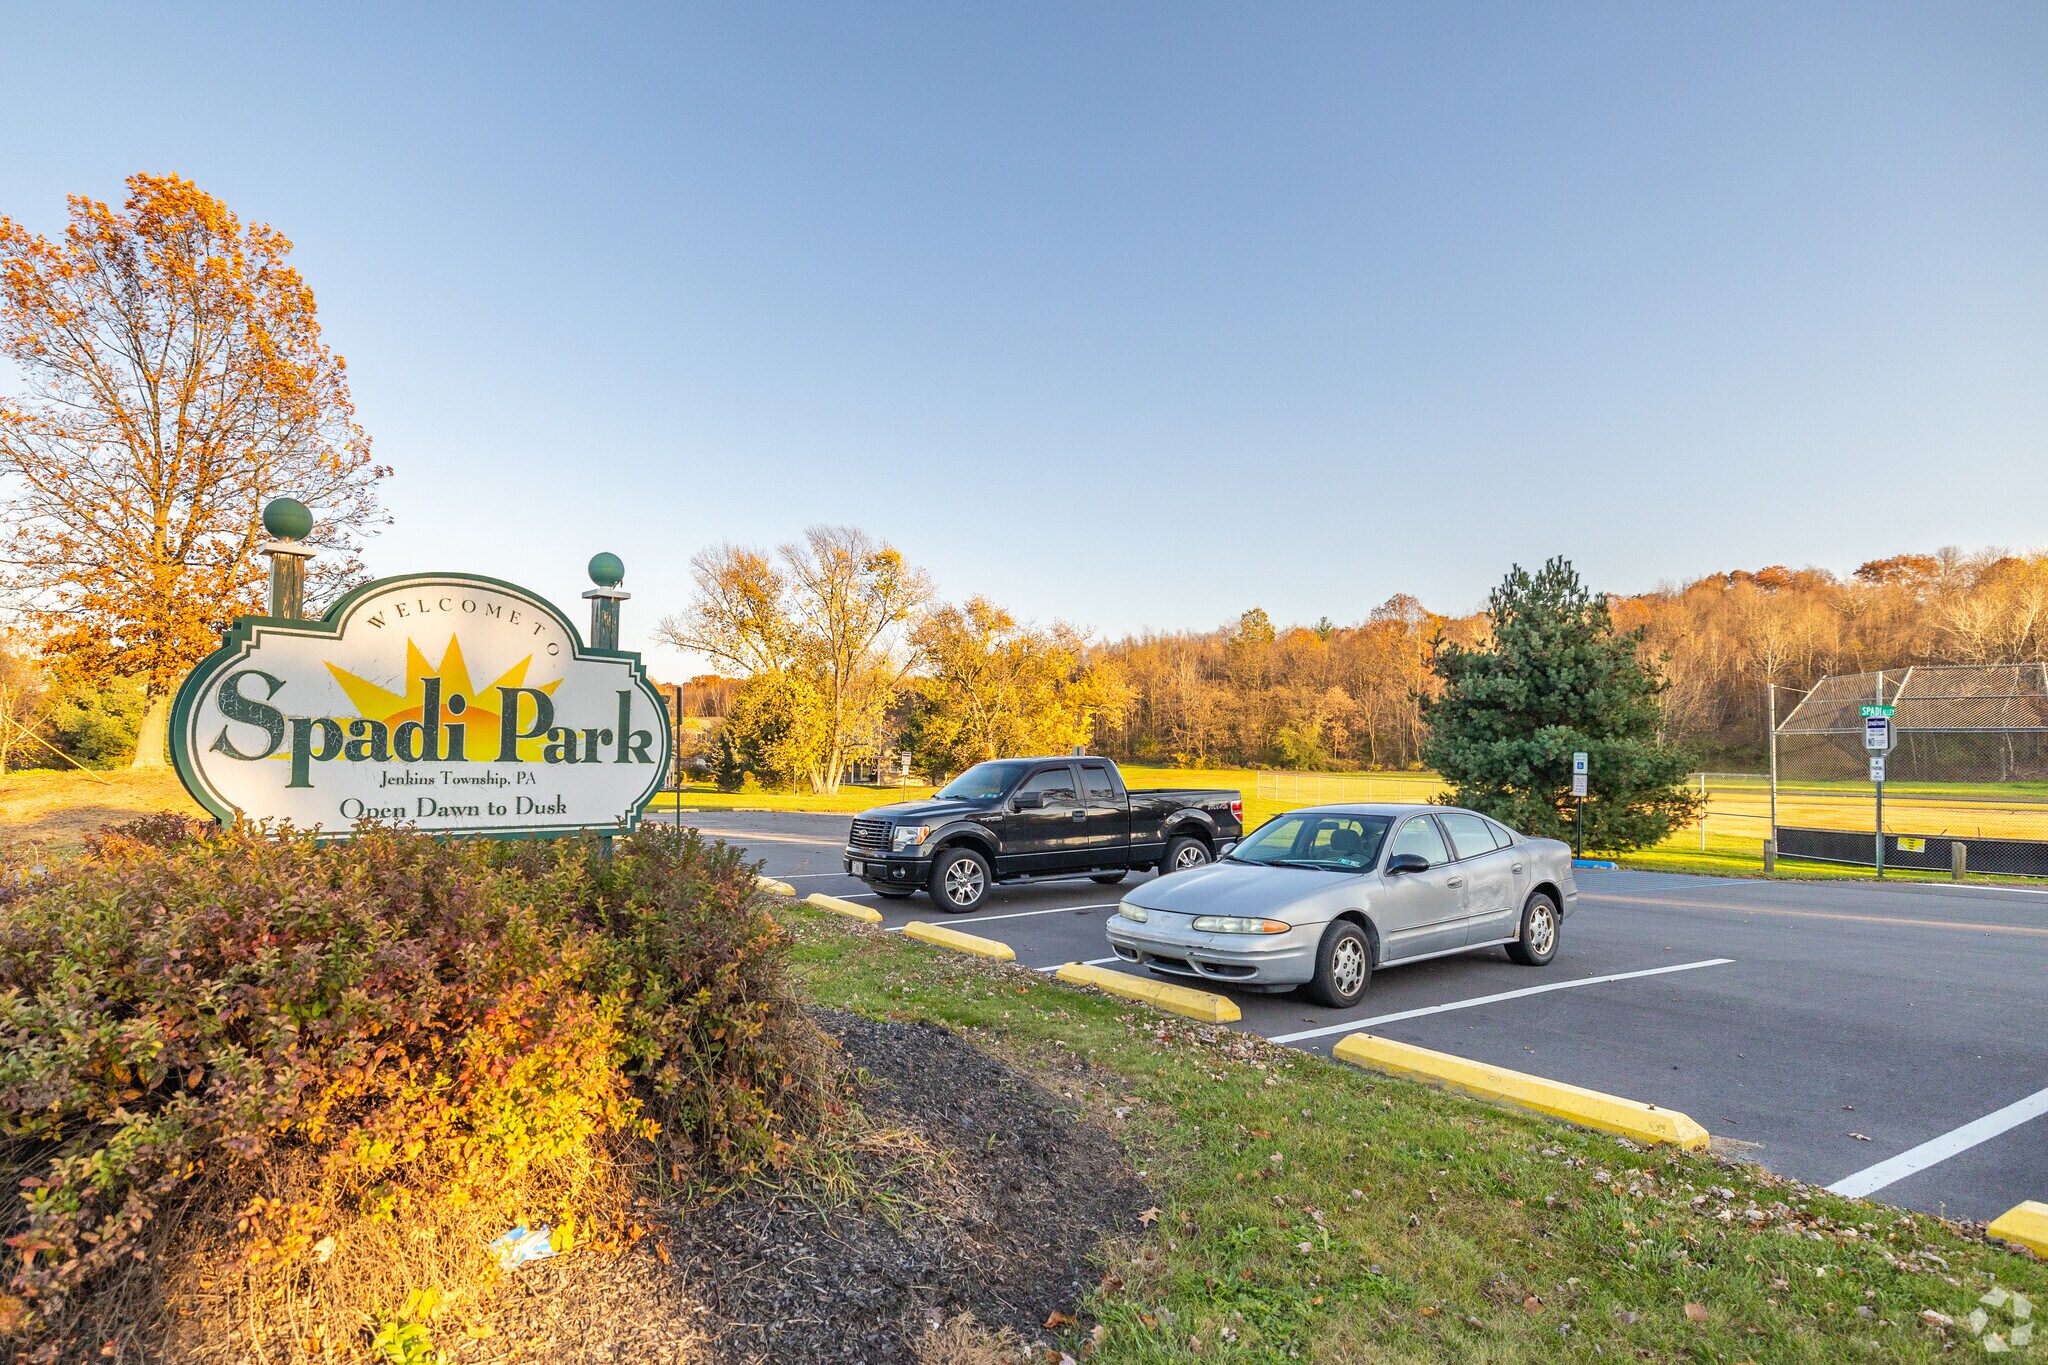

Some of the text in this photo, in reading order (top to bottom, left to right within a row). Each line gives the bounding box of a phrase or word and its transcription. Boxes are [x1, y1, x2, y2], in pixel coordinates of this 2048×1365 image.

[366, 597, 560, 657] WELCOME TO
[1861, 706, 1882, 716] SPADI
[209, 669, 655, 789] Spadi Park
[379, 769, 537, 788] Jenkins Township, PA
[339, 794, 567, 820] Open Dawn to Dusk
